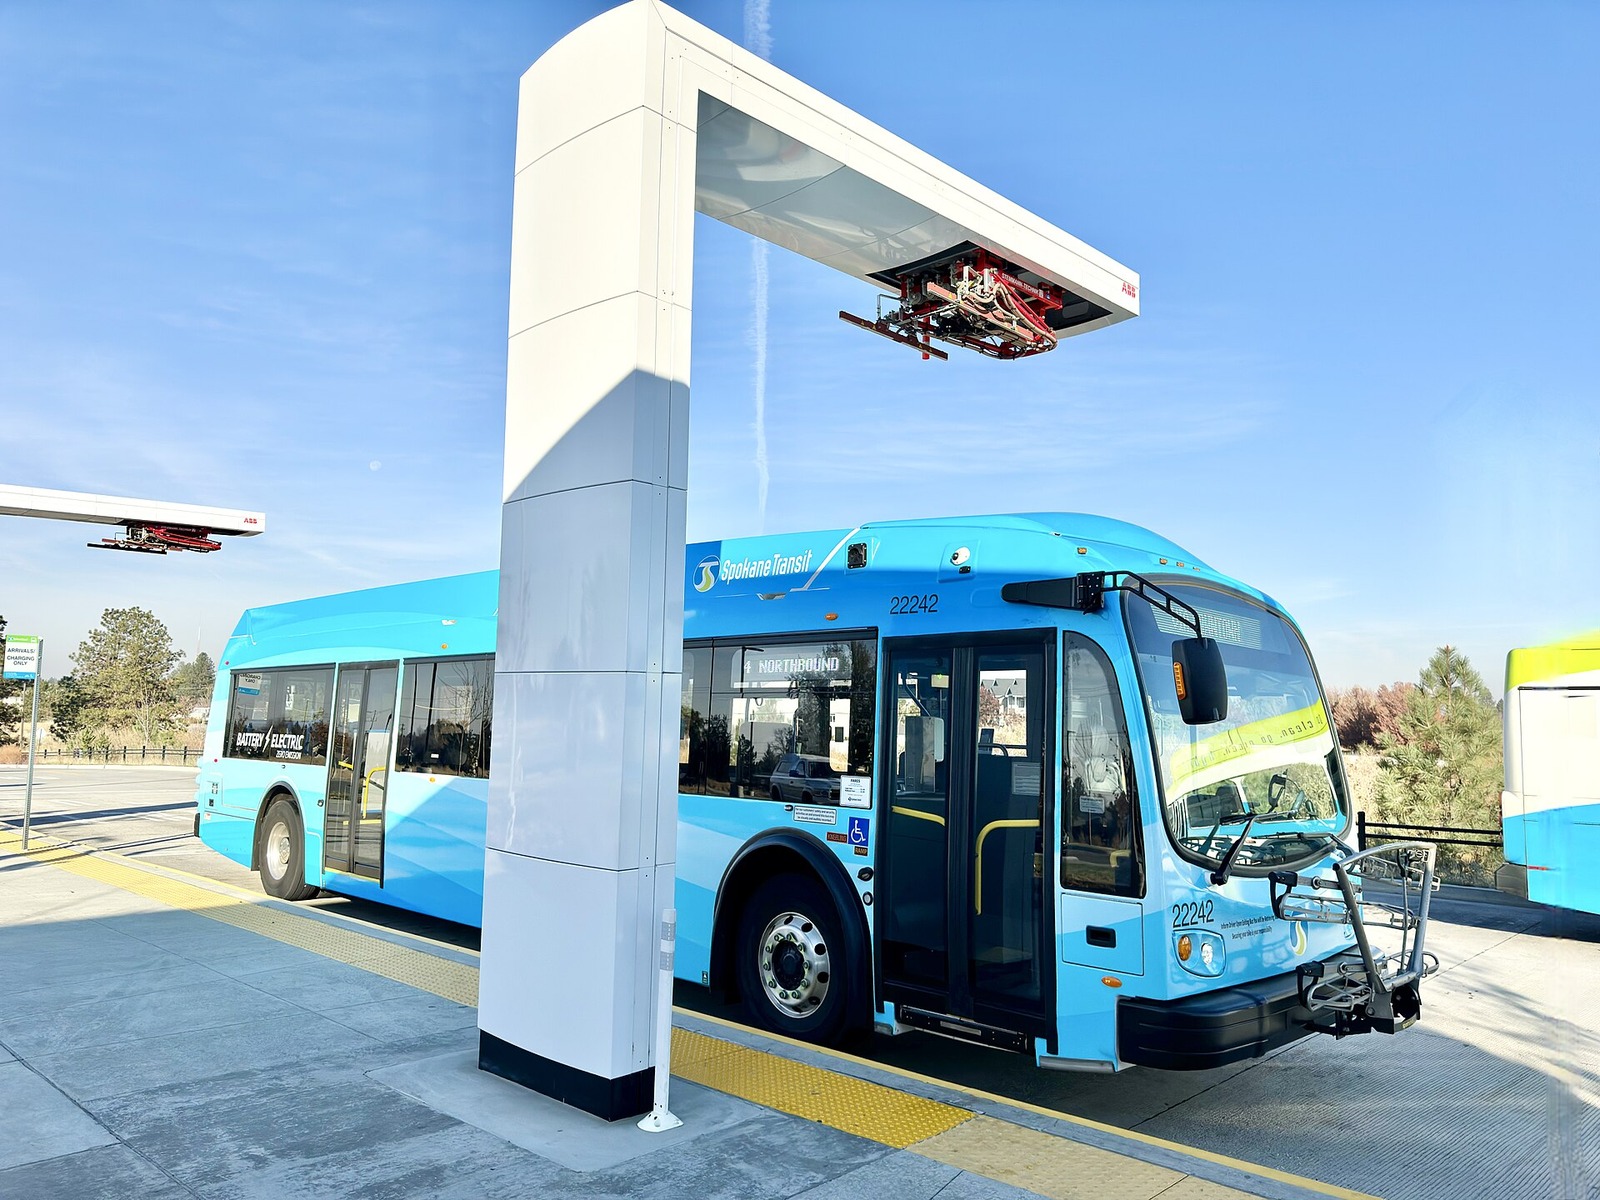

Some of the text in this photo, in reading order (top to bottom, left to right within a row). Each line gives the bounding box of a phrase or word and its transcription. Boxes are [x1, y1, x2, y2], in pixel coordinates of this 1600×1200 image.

[1122, 281, 1136, 298] ABB
[721, 549, 812, 585] Spokane Transit
[890, 594, 938, 615] 22242
[744, 657, 840, 674] 4 NORTHBOUND
[236, 732, 304, 750] BATTERY ELECTRIC
[1172, 900, 1214, 928] 22242
